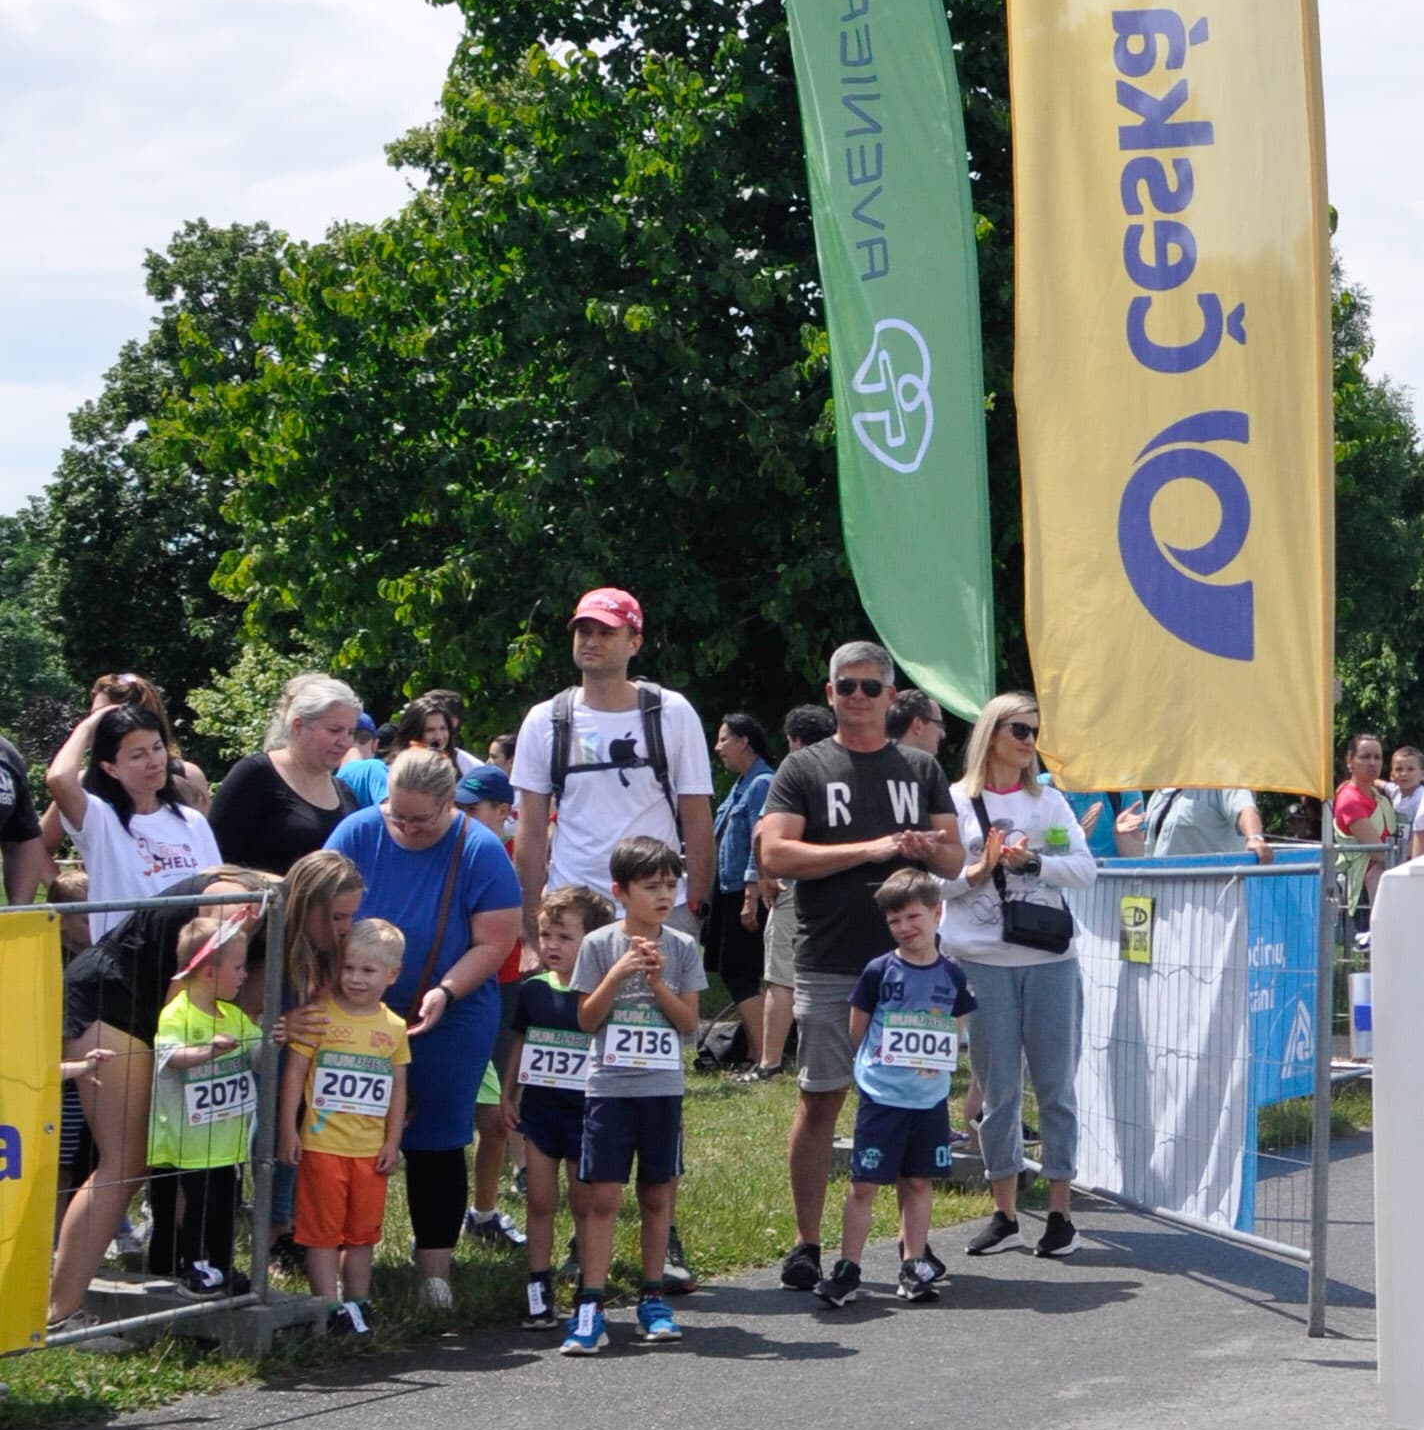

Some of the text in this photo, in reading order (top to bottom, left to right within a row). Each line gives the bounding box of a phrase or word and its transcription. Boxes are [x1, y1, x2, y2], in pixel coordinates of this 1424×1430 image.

[616, 1029, 672, 1055] 2136
[889, 1031, 952, 1057] 2004
[530, 1049, 587, 1075] 2137
[194, 1075, 249, 1110] 2079
[322, 1072, 385, 1101] 2076
